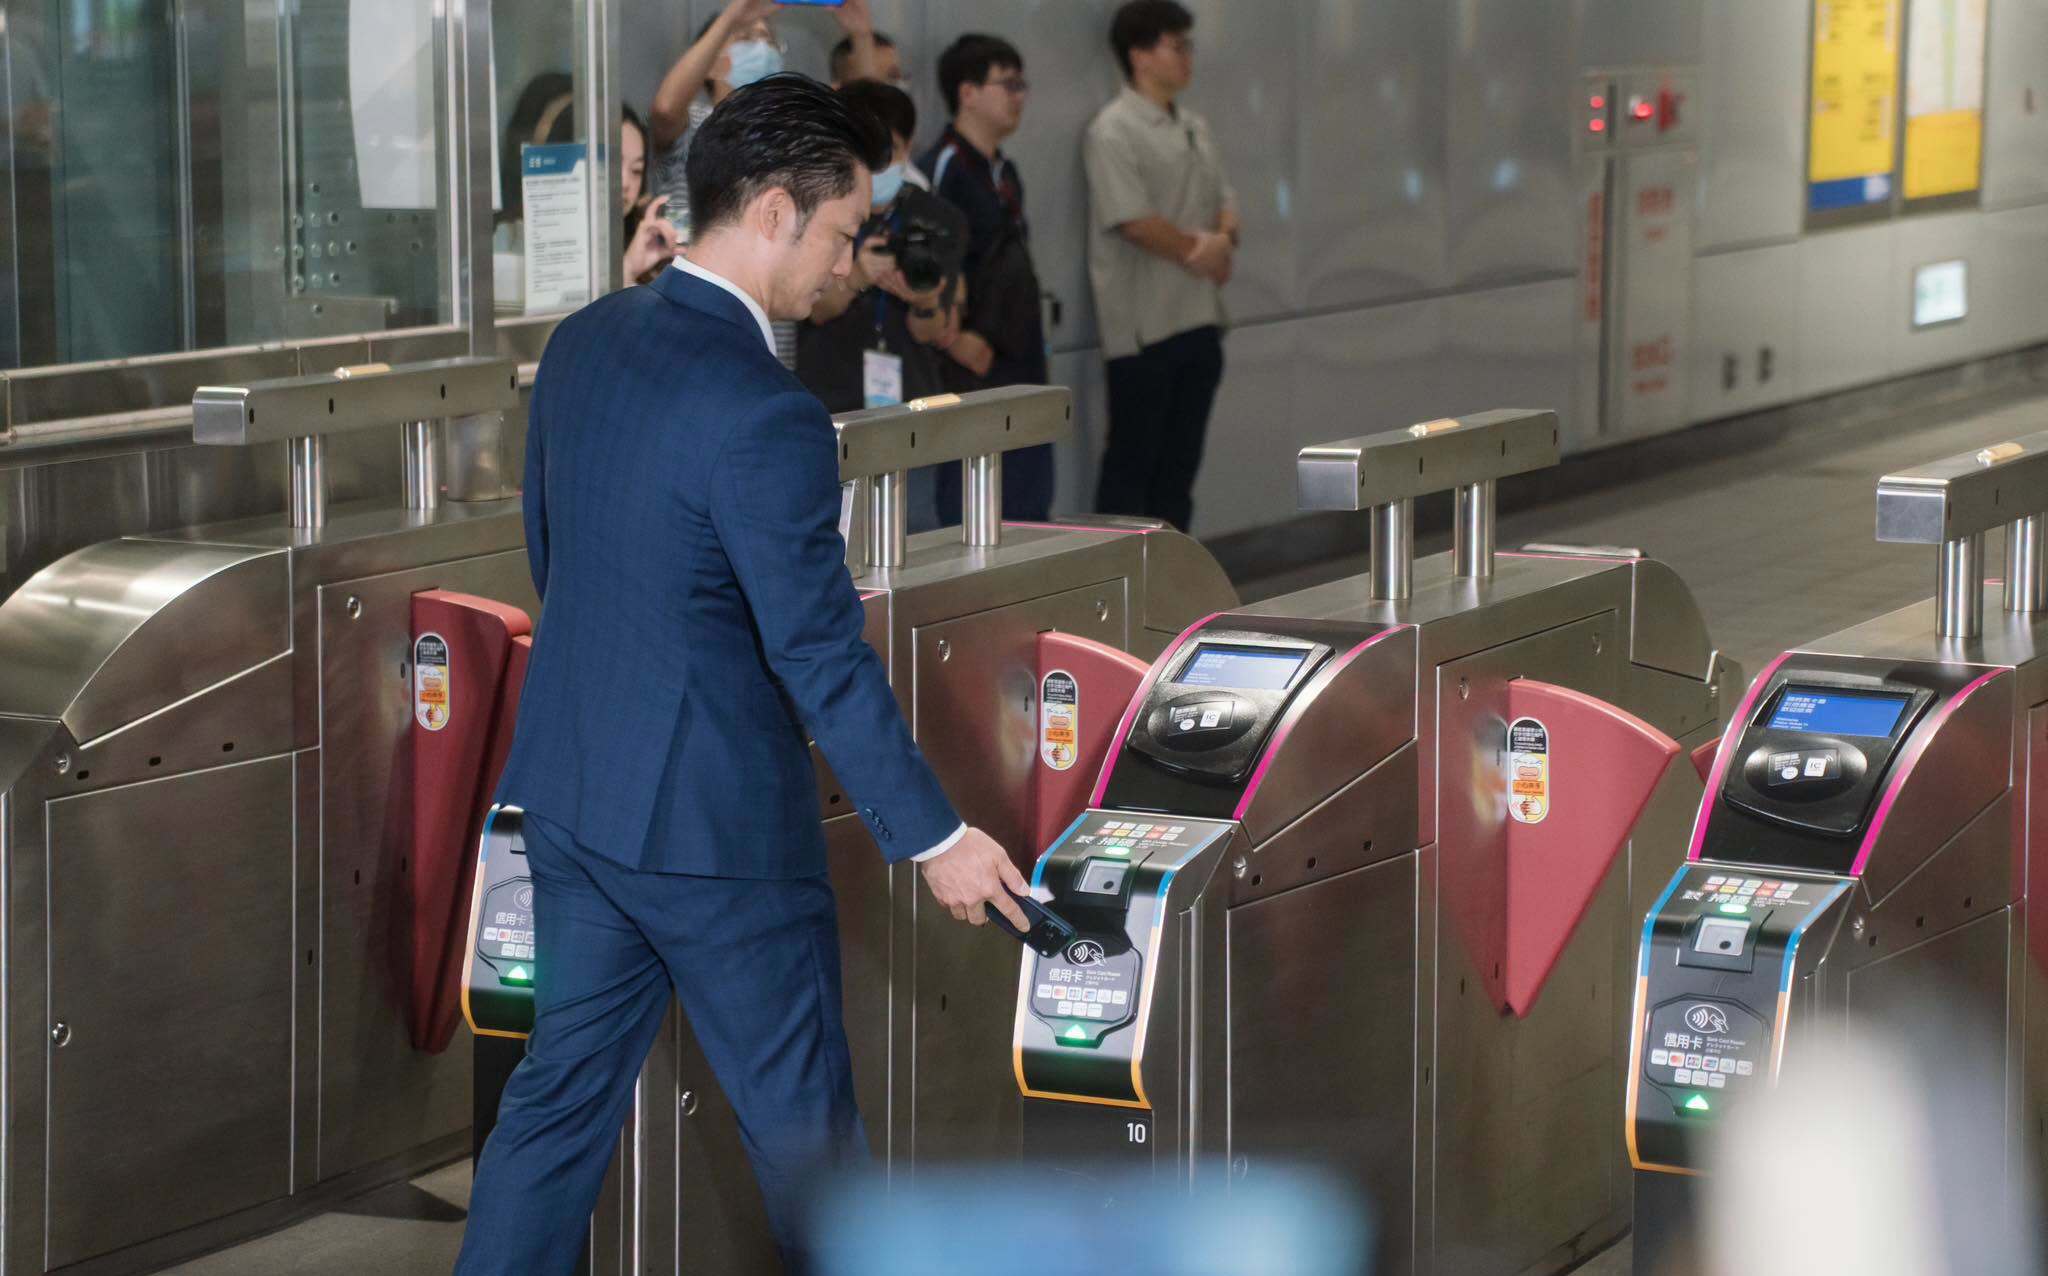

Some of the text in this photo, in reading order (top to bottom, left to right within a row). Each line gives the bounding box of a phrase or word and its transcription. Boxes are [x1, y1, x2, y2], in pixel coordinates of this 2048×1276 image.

[495, 911, 526, 926] 信用卡
[1049, 968, 1083, 983] 信用卡
[1664, 1032, 1703, 1050] 信用卡
[1127, 1122, 1146, 1143] 10
